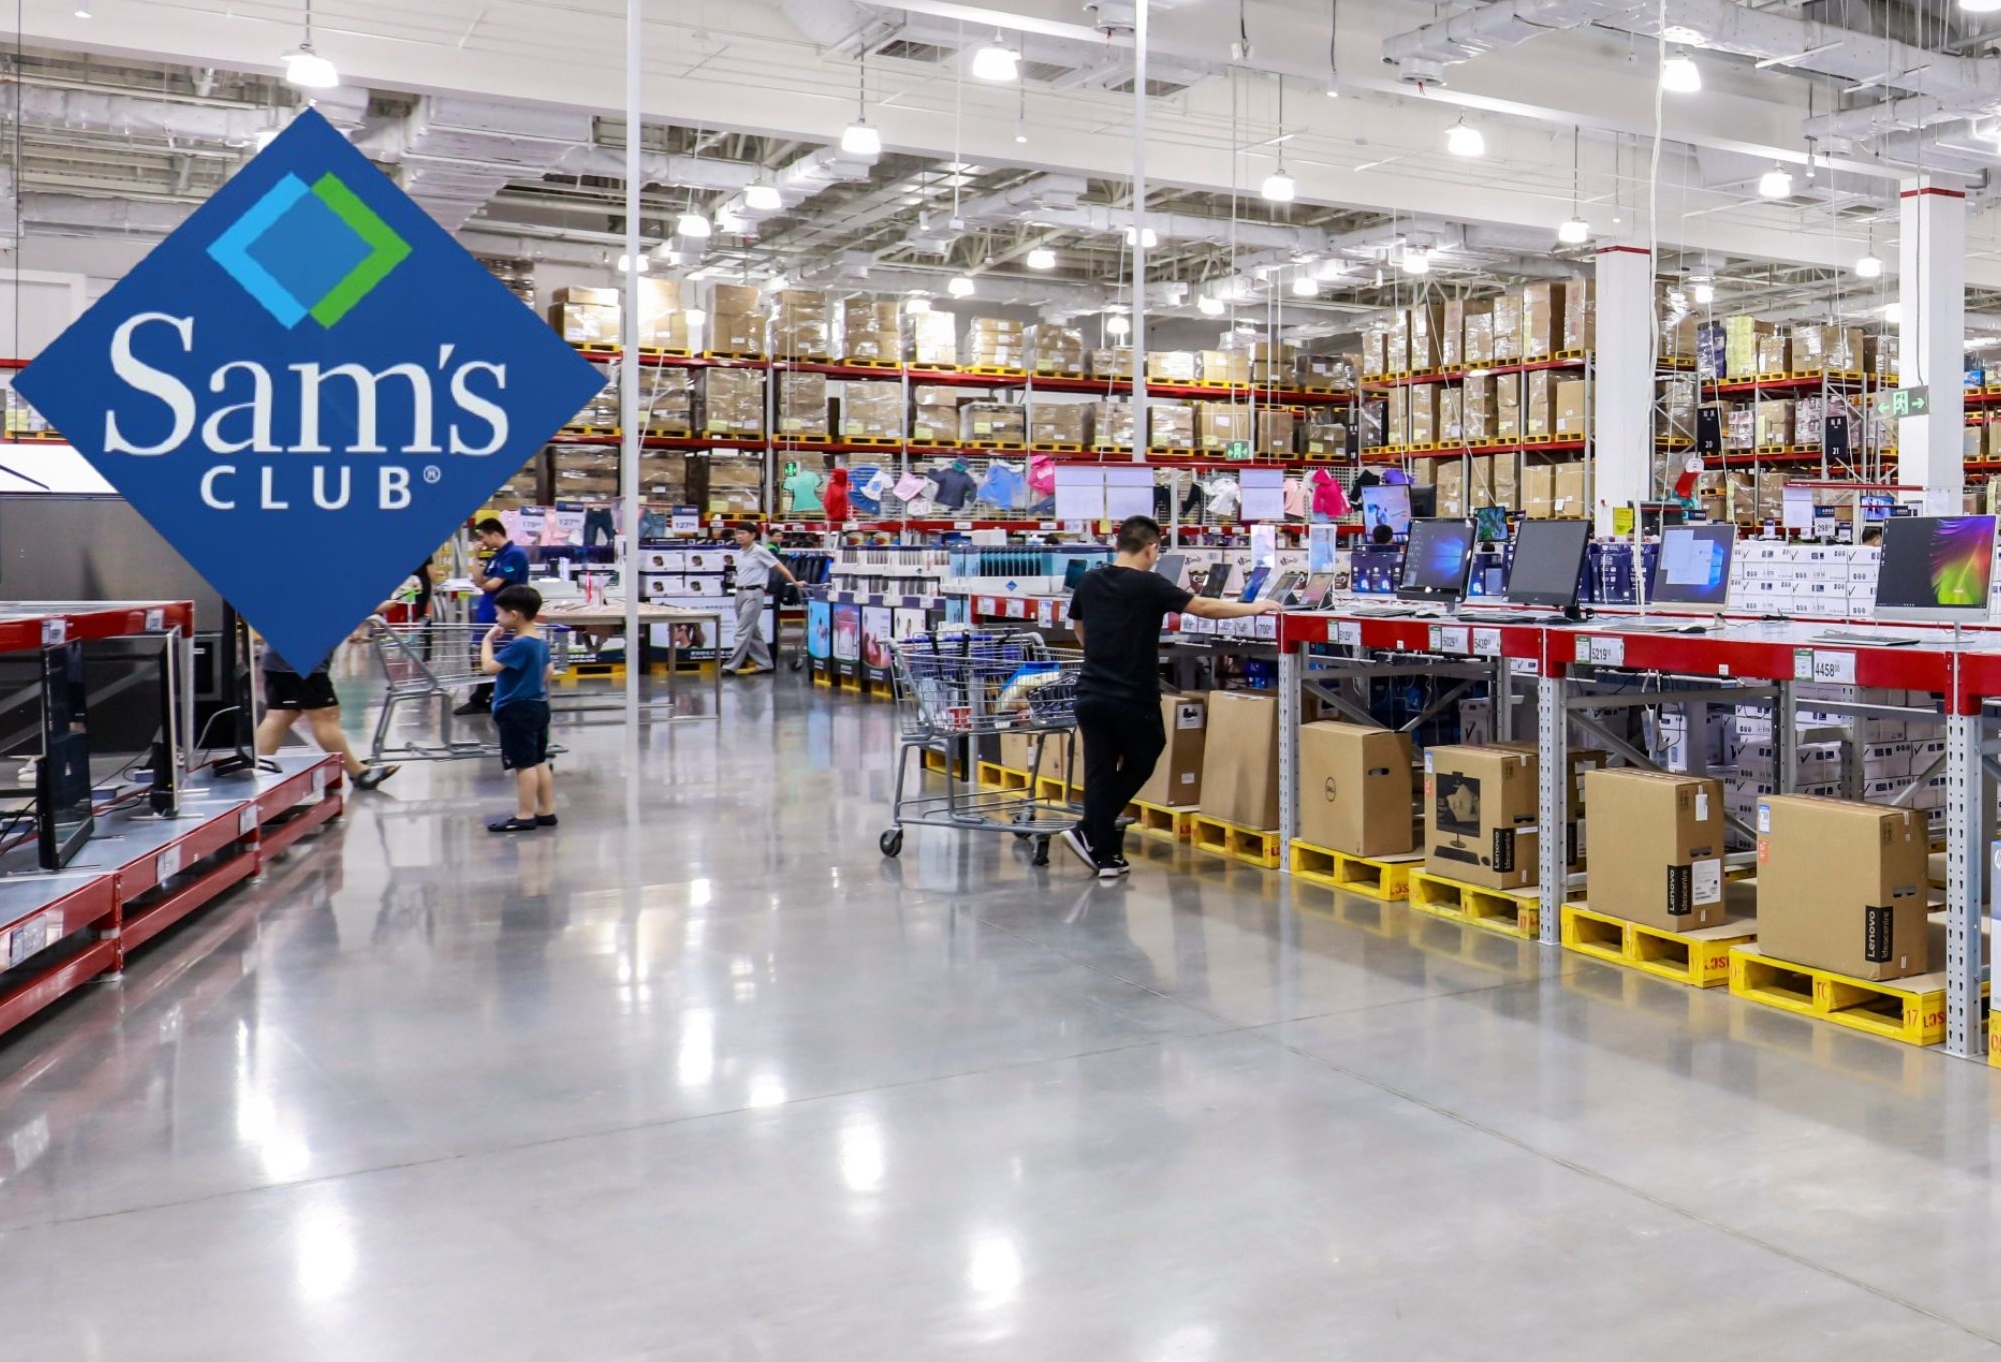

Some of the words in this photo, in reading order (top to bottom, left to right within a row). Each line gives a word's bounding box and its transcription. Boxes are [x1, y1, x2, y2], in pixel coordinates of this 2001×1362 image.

[1705, 440, 1714, 449] 20
[1832, 447, 1840, 455] 21
[1591, 645, 1607, 661] 5219
[1815, 662, 1835, 677] 4458
[1867, 910, 1876, 958] Lenovo
